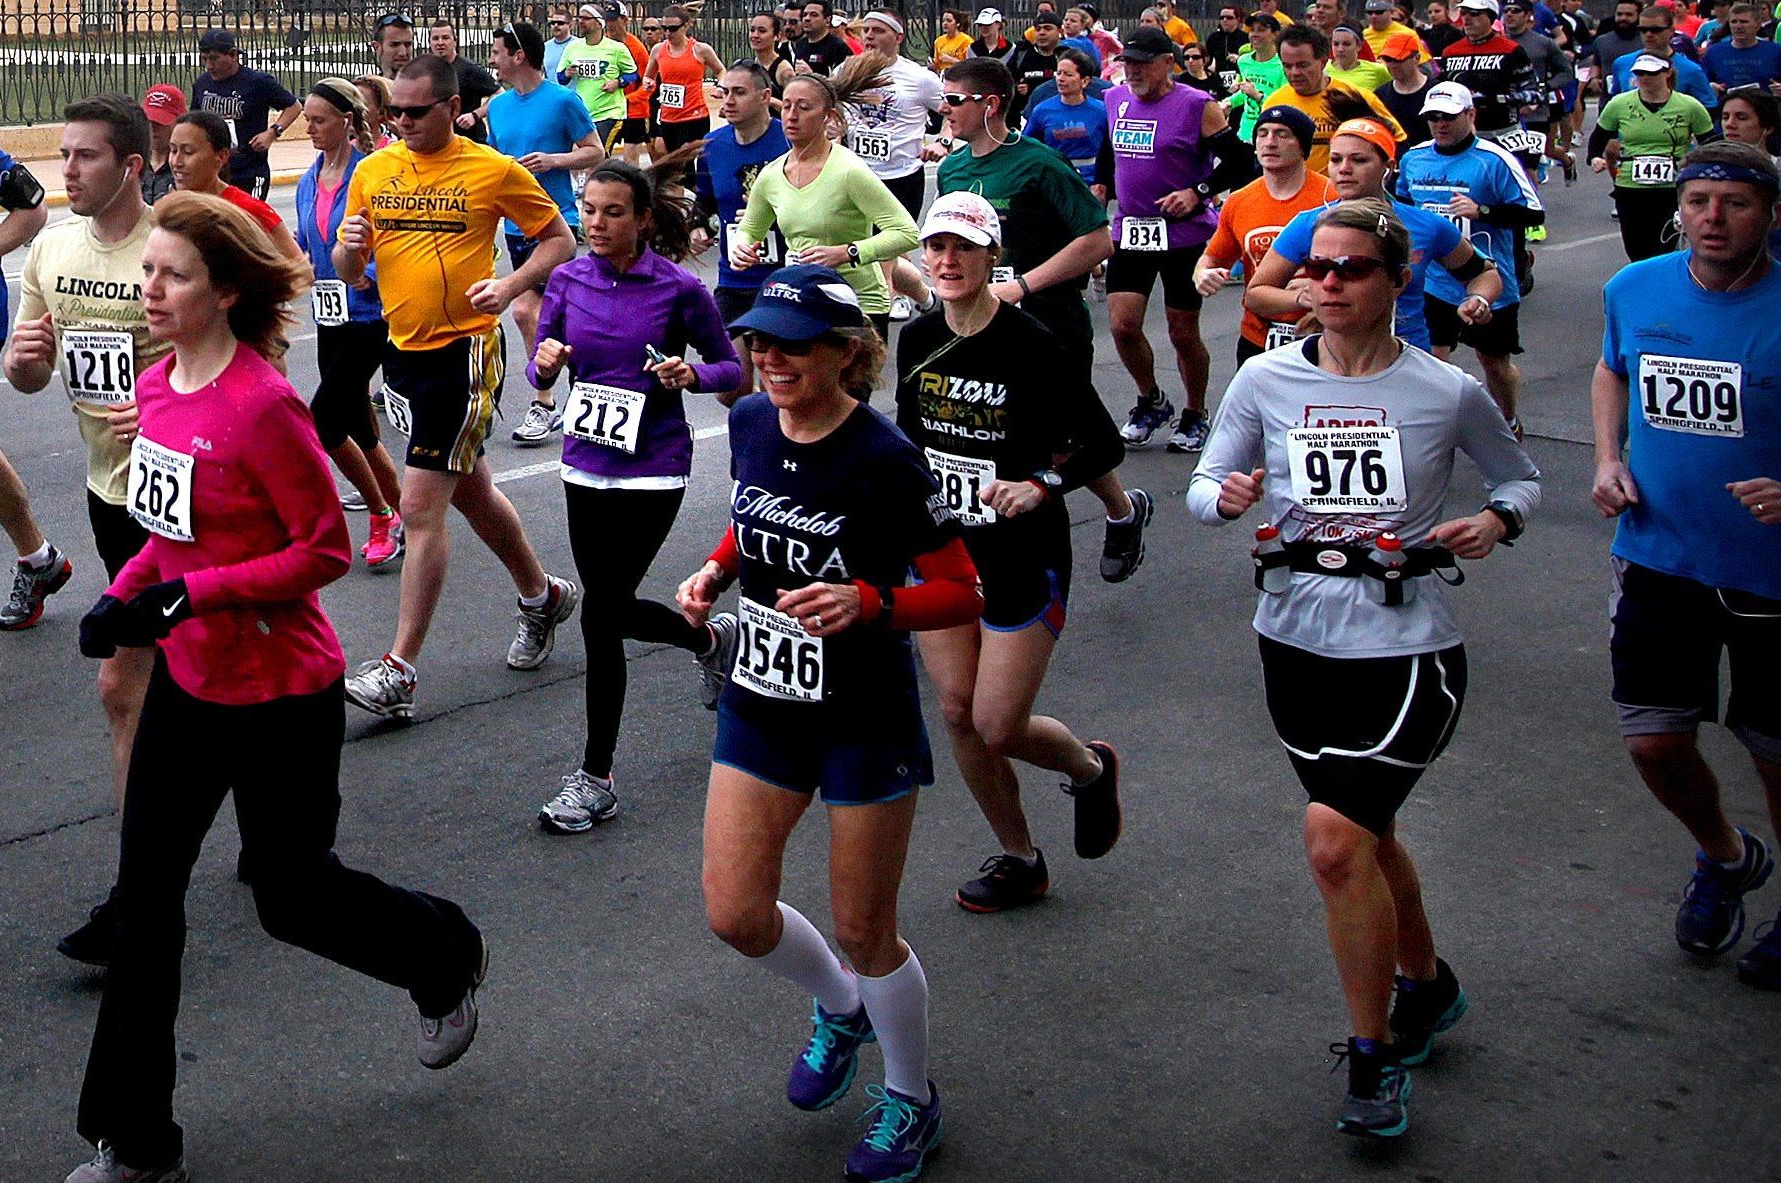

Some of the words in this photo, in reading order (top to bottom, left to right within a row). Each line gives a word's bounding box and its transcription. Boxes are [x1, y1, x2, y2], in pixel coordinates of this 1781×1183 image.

[1446, 56, 1471, 72] STAR
[1472, 55, 1505, 70] TREK
[663, 90, 680, 103] 765
[1115, 131, 1152, 145] TEAM
[855, 137, 888, 156] 1563
[1634, 164, 1671, 179] 1447
[412, 180, 468, 196] Lincoln
[371, 196, 469, 212] PRESIDENTIAL
[1129, 227, 1161, 246] 834
[55, 276, 142, 301] LINCOLN
[763, 288, 802, 302] ULTRA
[317, 292, 342, 316] 793
[90, 336, 128, 344] PRESIDENTIAL
[66, 350, 132, 392] 1218
[1647, 359, 1678, 368] LINCOLN
[1680, 362, 1733, 374] PRESIDENTIAL
[1679, 370, 1722, 380] MARATHON
[1643, 375, 1738, 422] 1209
[574, 399, 629, 442] 212
[192, 436, 212, 451] FILA
[1294, 433, 1328, 441] LINCOLN
[1330, 432, 1391, 440] PRESIDENTIAL
[1330, 440, 1379, 448] MARATHON
[1305, 450, 1388, 496] 976
[135, 462, 179, 526] 262
[1302, 498, 1383, 507] SPRINGFIELD,
[1386, 498, 1398, 506] IL
[735, 486, 846, 536] Michelob
[731, 518, 850, 578] LTRA
[738, 622, 820, 690] 1546
